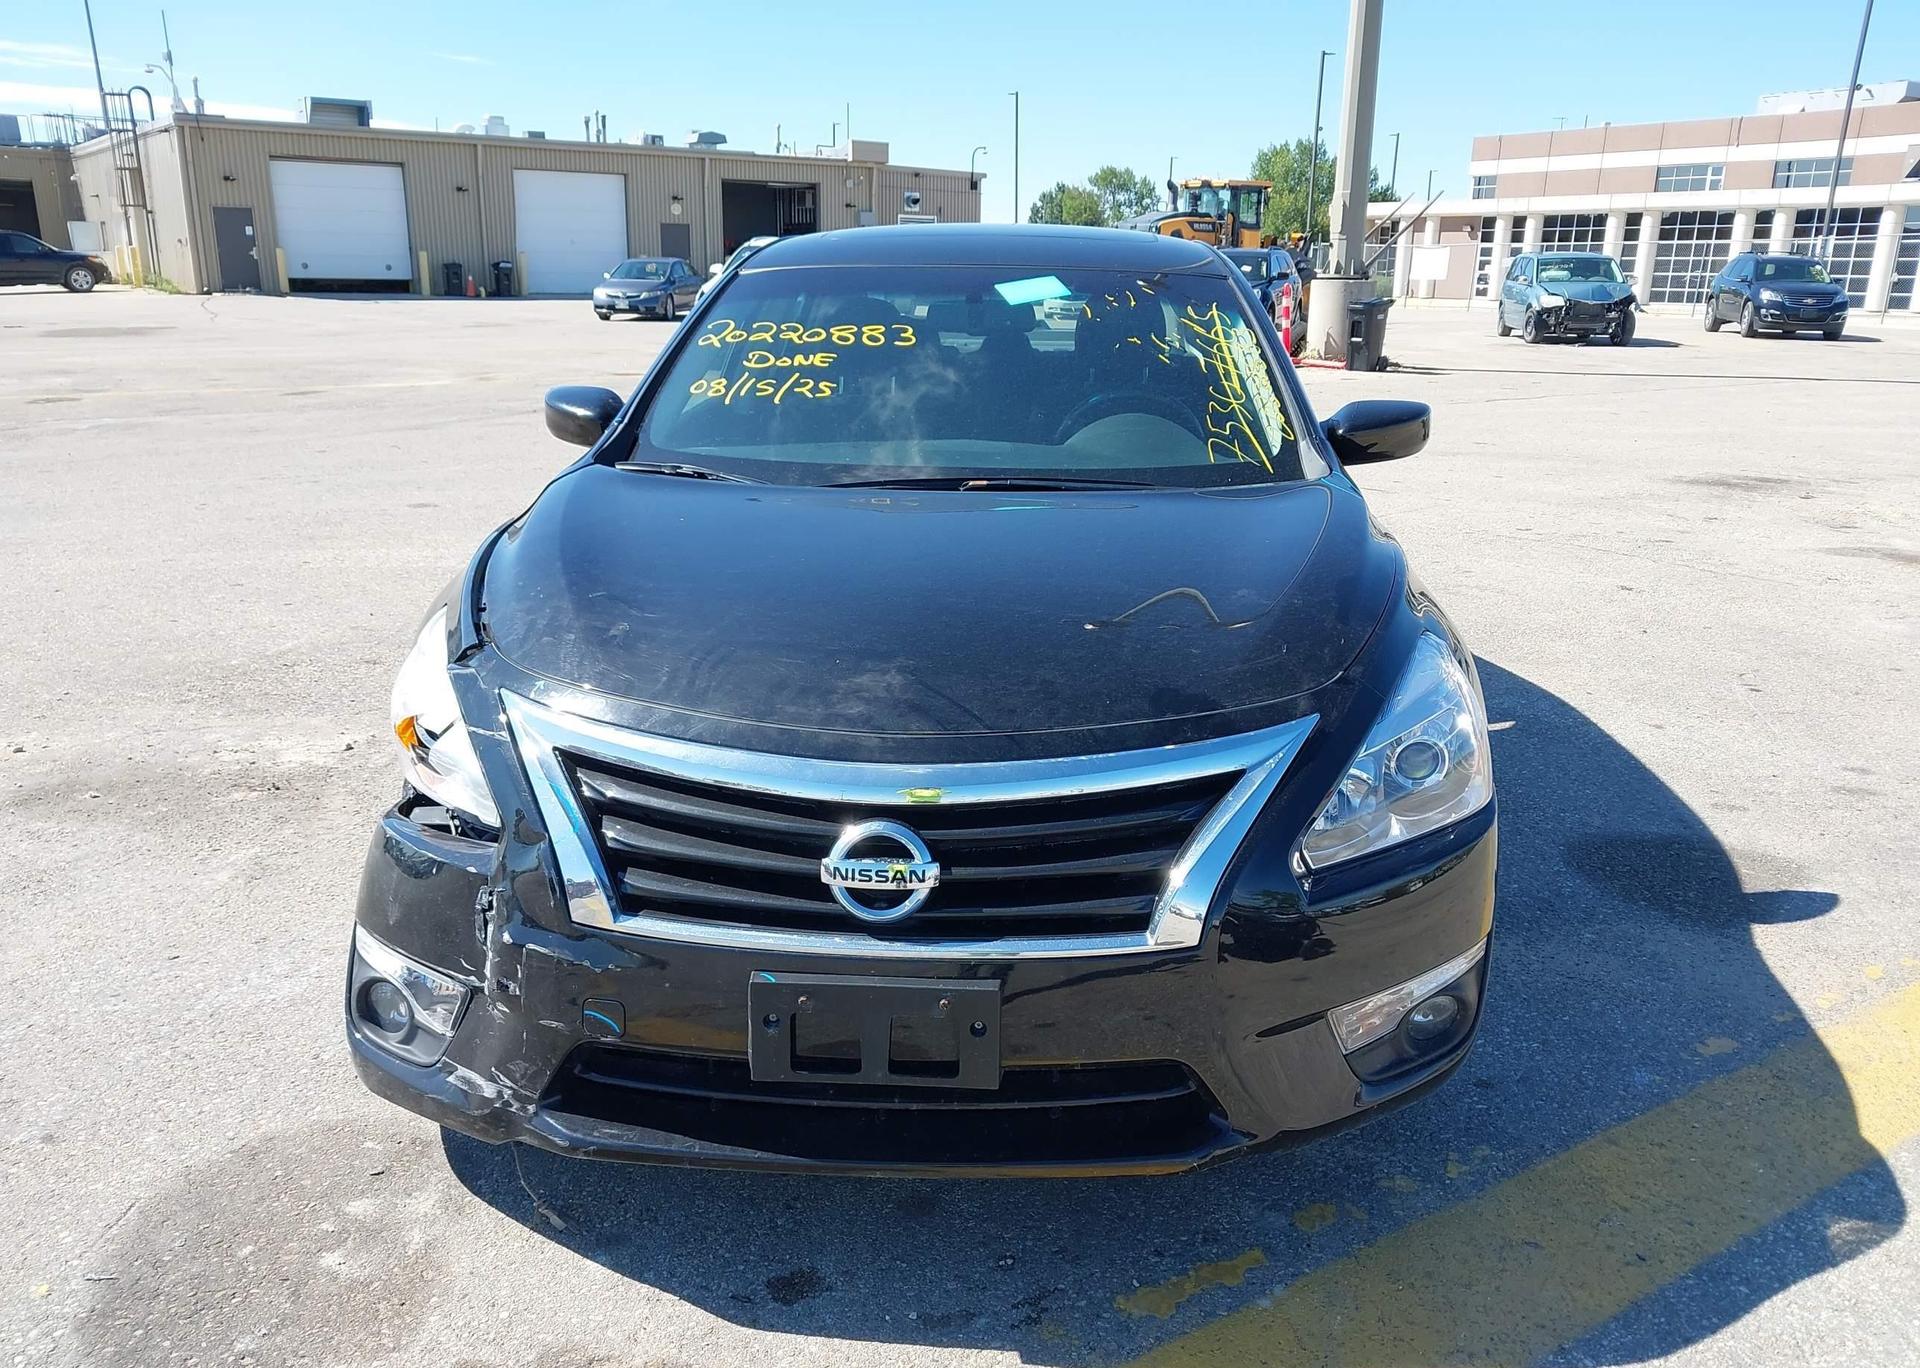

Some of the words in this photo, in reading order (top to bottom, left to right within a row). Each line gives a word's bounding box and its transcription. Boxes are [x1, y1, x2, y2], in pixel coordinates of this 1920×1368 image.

[698, 319, 917, 348] 20220883
[689, 371, 838, 405] 08/15/25
[832, 866, 926, 884] NISSAN
